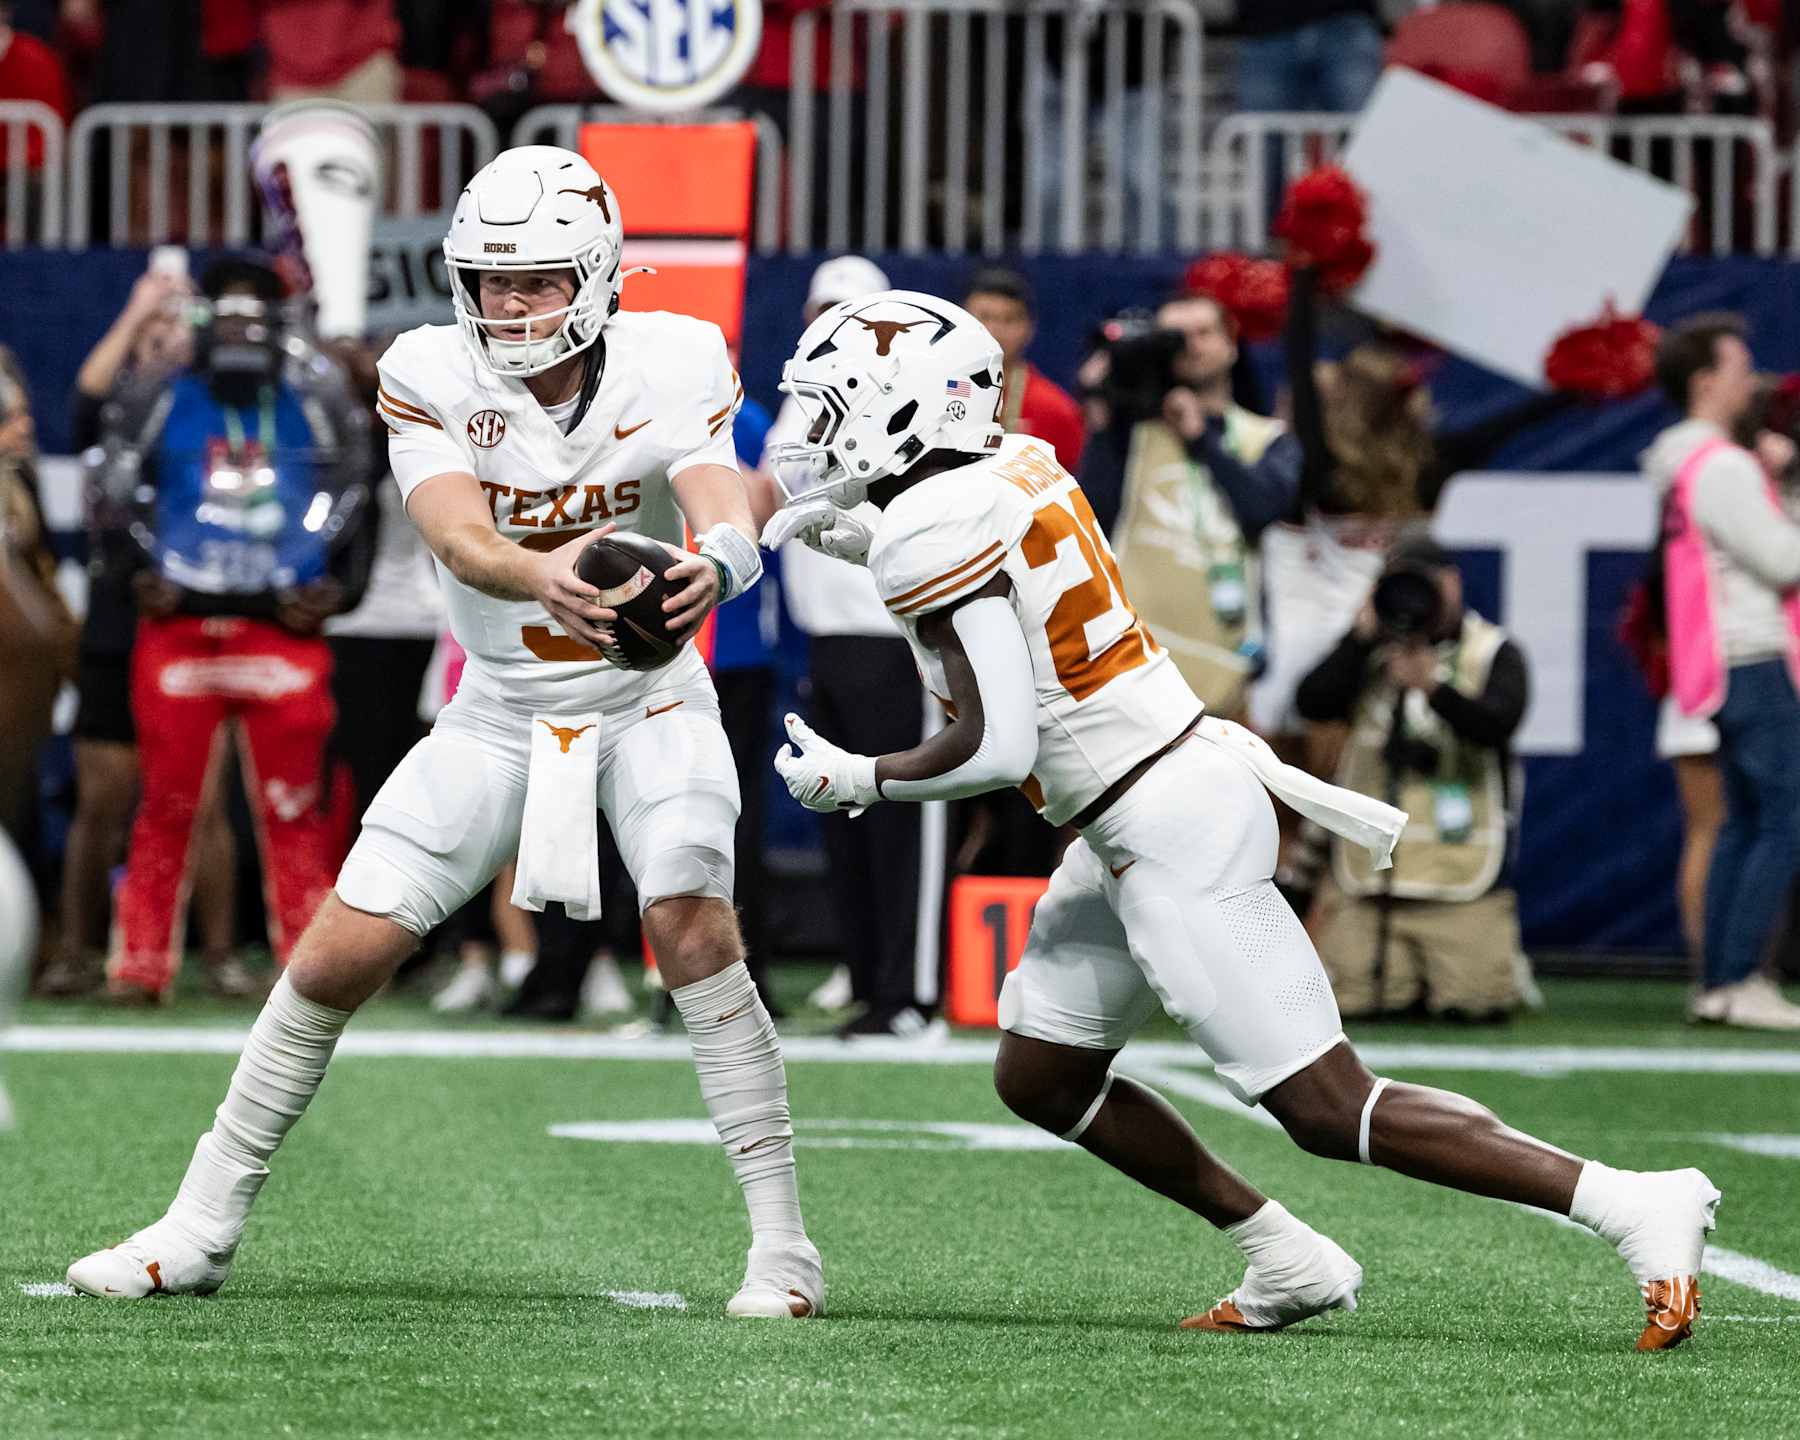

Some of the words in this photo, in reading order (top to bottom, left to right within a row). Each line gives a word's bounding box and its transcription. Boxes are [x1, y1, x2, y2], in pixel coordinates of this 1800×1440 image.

[483, 242, 517, 253] HORNS
[468, 410, 506, 448] SEC
[480, 480, 641, 528] TEXAS
